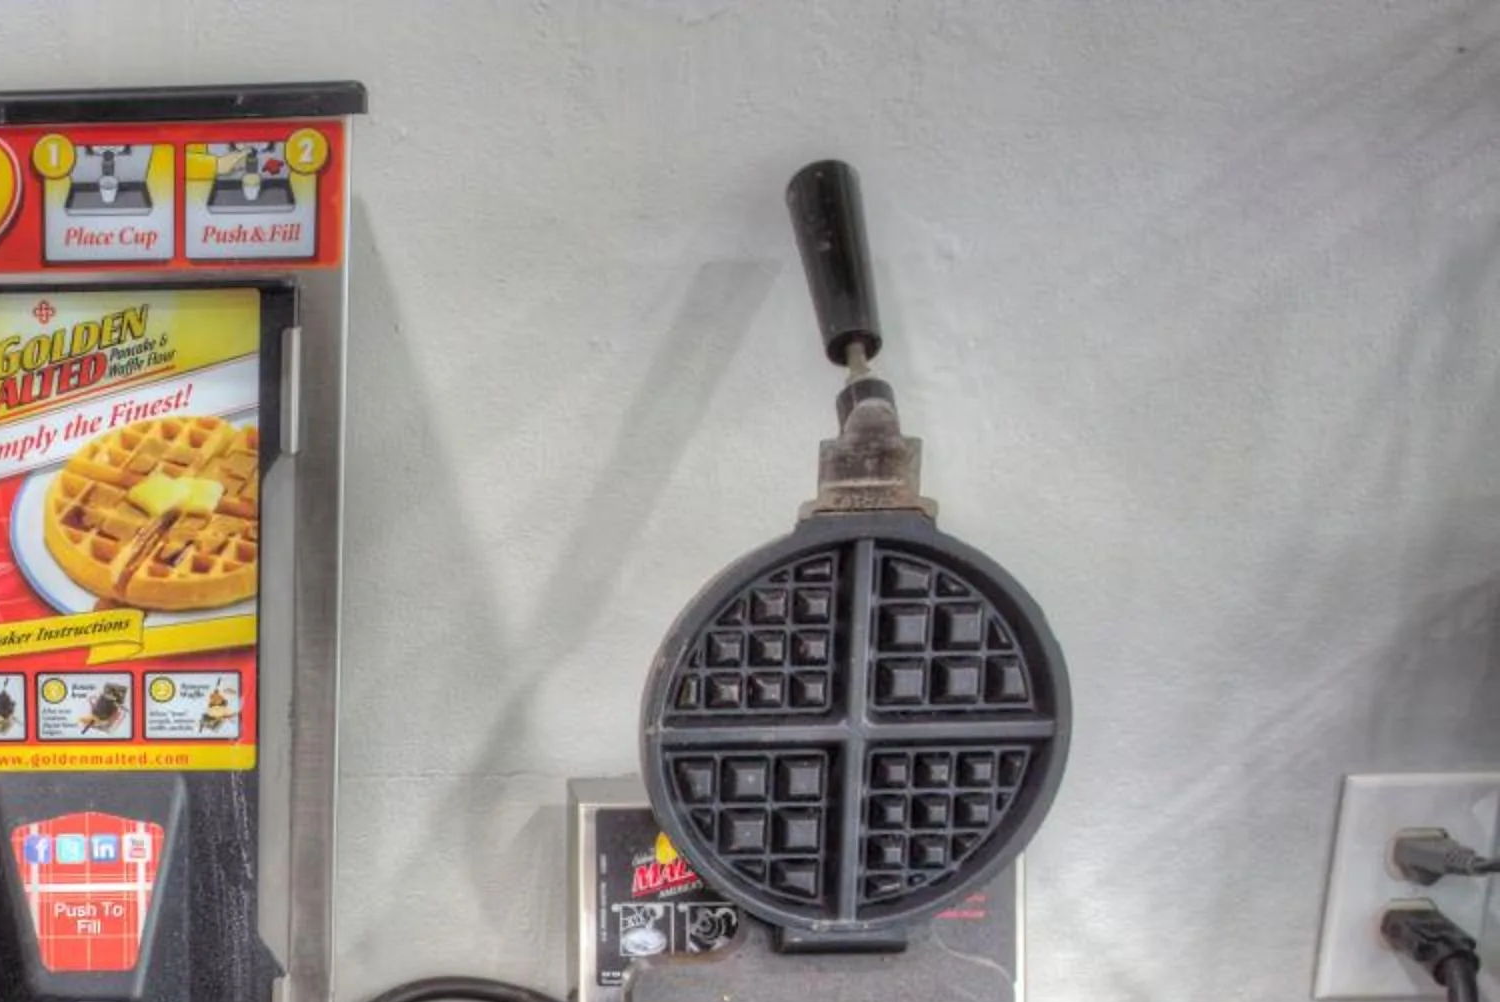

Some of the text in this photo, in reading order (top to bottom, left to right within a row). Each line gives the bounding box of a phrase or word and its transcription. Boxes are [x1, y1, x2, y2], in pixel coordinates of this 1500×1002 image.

[48, 141, 60, 167] 1
[300, 138, 313, 163] 2
[64, 226, 158, 249] Place Cup
[202, 223, 249, 244] Push
[267, 222, 302, 243] Fill
[63, 413, 103, 441] the
[107, 383, 194, 428] Finest!
[35, 616, 132, 642] Instructions
[54, 901, 125, 918] Push To
[76, 919, 102, 935] Fill
